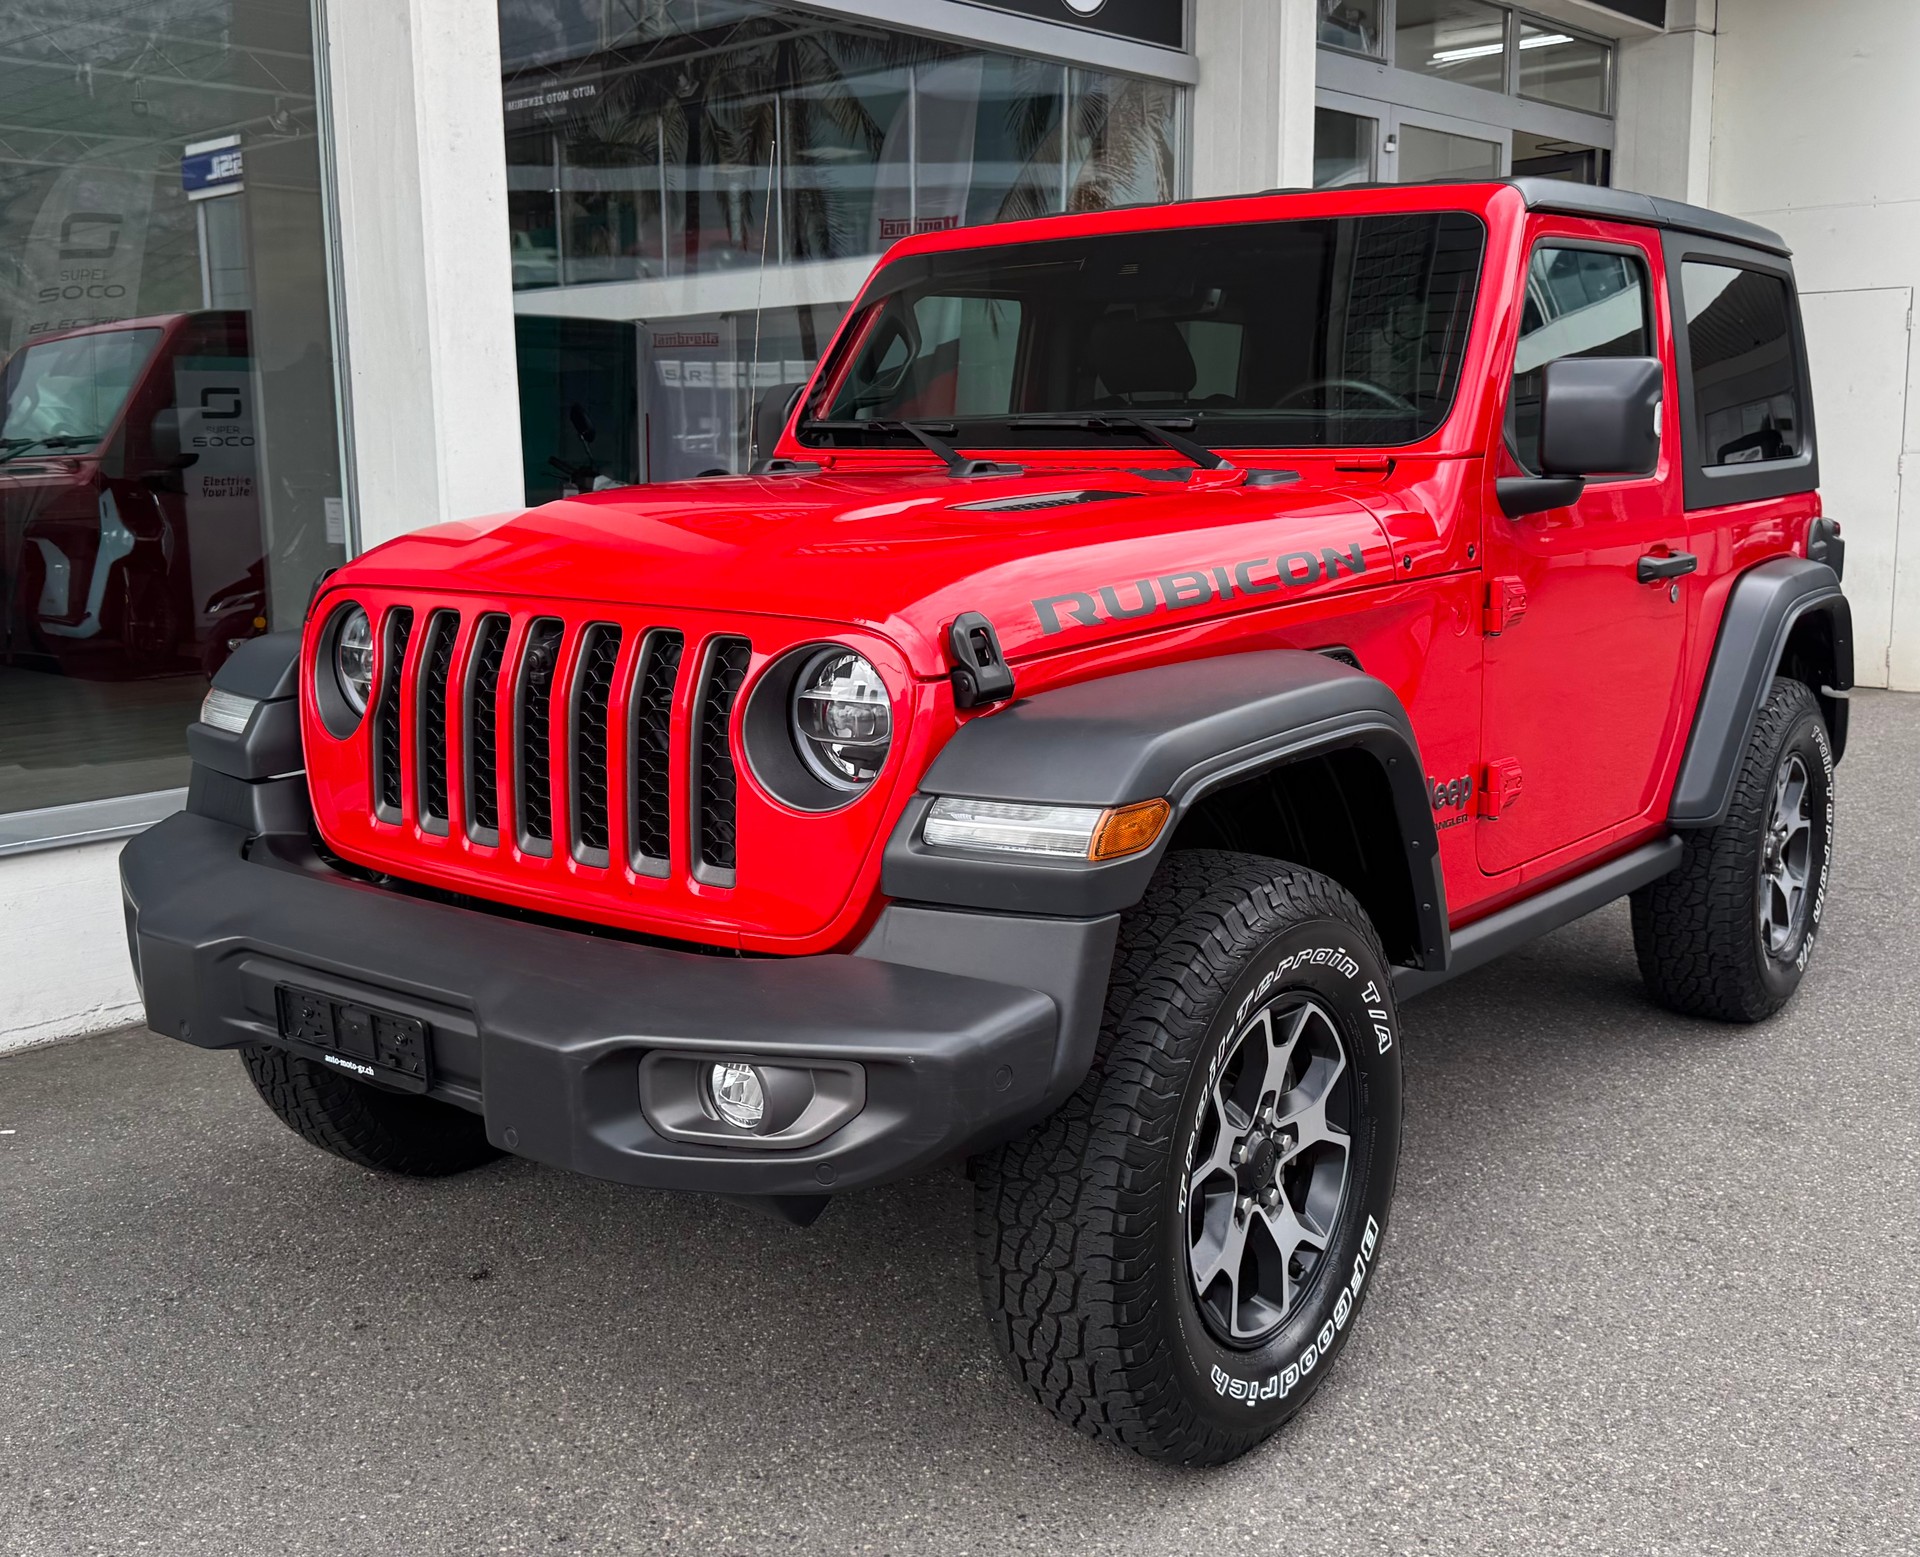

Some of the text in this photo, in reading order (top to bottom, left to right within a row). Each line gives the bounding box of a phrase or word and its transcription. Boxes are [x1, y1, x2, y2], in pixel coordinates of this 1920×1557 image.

[38, 284, 126, 304] SOCO
[206, 425, 240, 434] SUPER
[192, 436, 255, 447] SOCO
[202, 487, 227, 498] Your
[1031, 543, 1366, 635] RUBICON
[1426, 774, 1473, 810] Jeep
[1434, 814, 1468, 830] ANGLER
[1210, 1214, 1379, 1406] BFGoodrich
